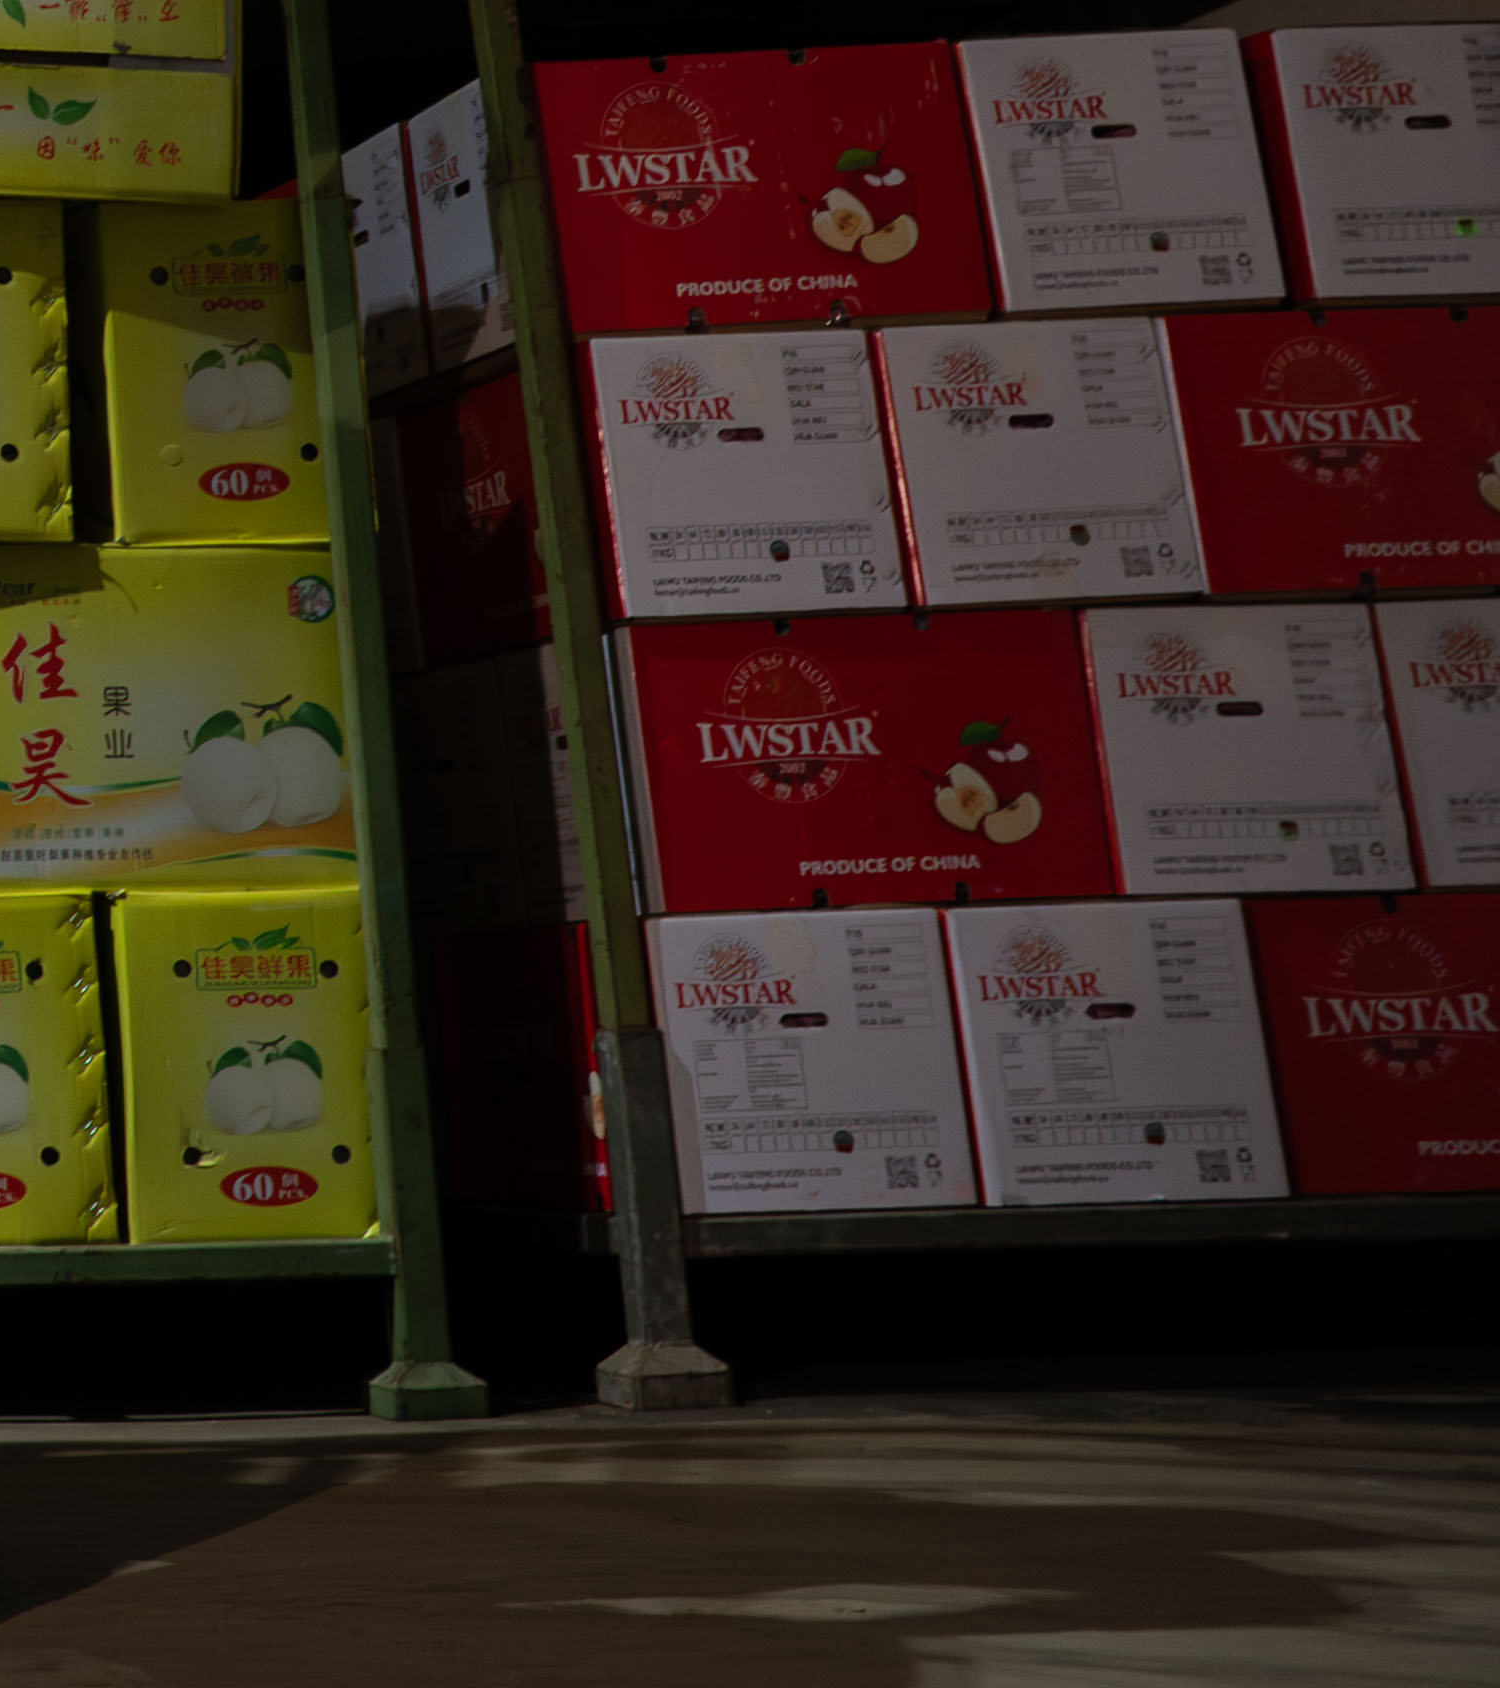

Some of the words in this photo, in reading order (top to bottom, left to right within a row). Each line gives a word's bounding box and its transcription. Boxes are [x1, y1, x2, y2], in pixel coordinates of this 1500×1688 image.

[992, 92, 1108, 126] LWSTAR
[1302, 80, 1417, 112] LWSTAR
[573, 146, 759, 192] LWSTAR
[675, 278, 763, 298] PRODUCE
[765, 274, 794, 295] OF
[796, 273, 859, 291] CHINA
[1235, 404, 1422, 447] LWSTAR
[210, 469, 249, 496] 60
[1116, 666, 1235, 699] LWSTAR
[1, 621, 94, 808] 佳昊
[102, 686, 135, 760] 果业
[696, 717, 881, 763] LWSTAR
[798, 857, 888, 877] PRODUCE
[890, 855, 916, 873] OF
[920, 854, 982, 872] CHINA
[201, 953, 312, 983] 佳昊鲜果
[673, 977, 797, 1010] LWSTAR
[1303, 992, 1499, 1038] LWSTAR
[232, 1173, 274, 1201] 60
